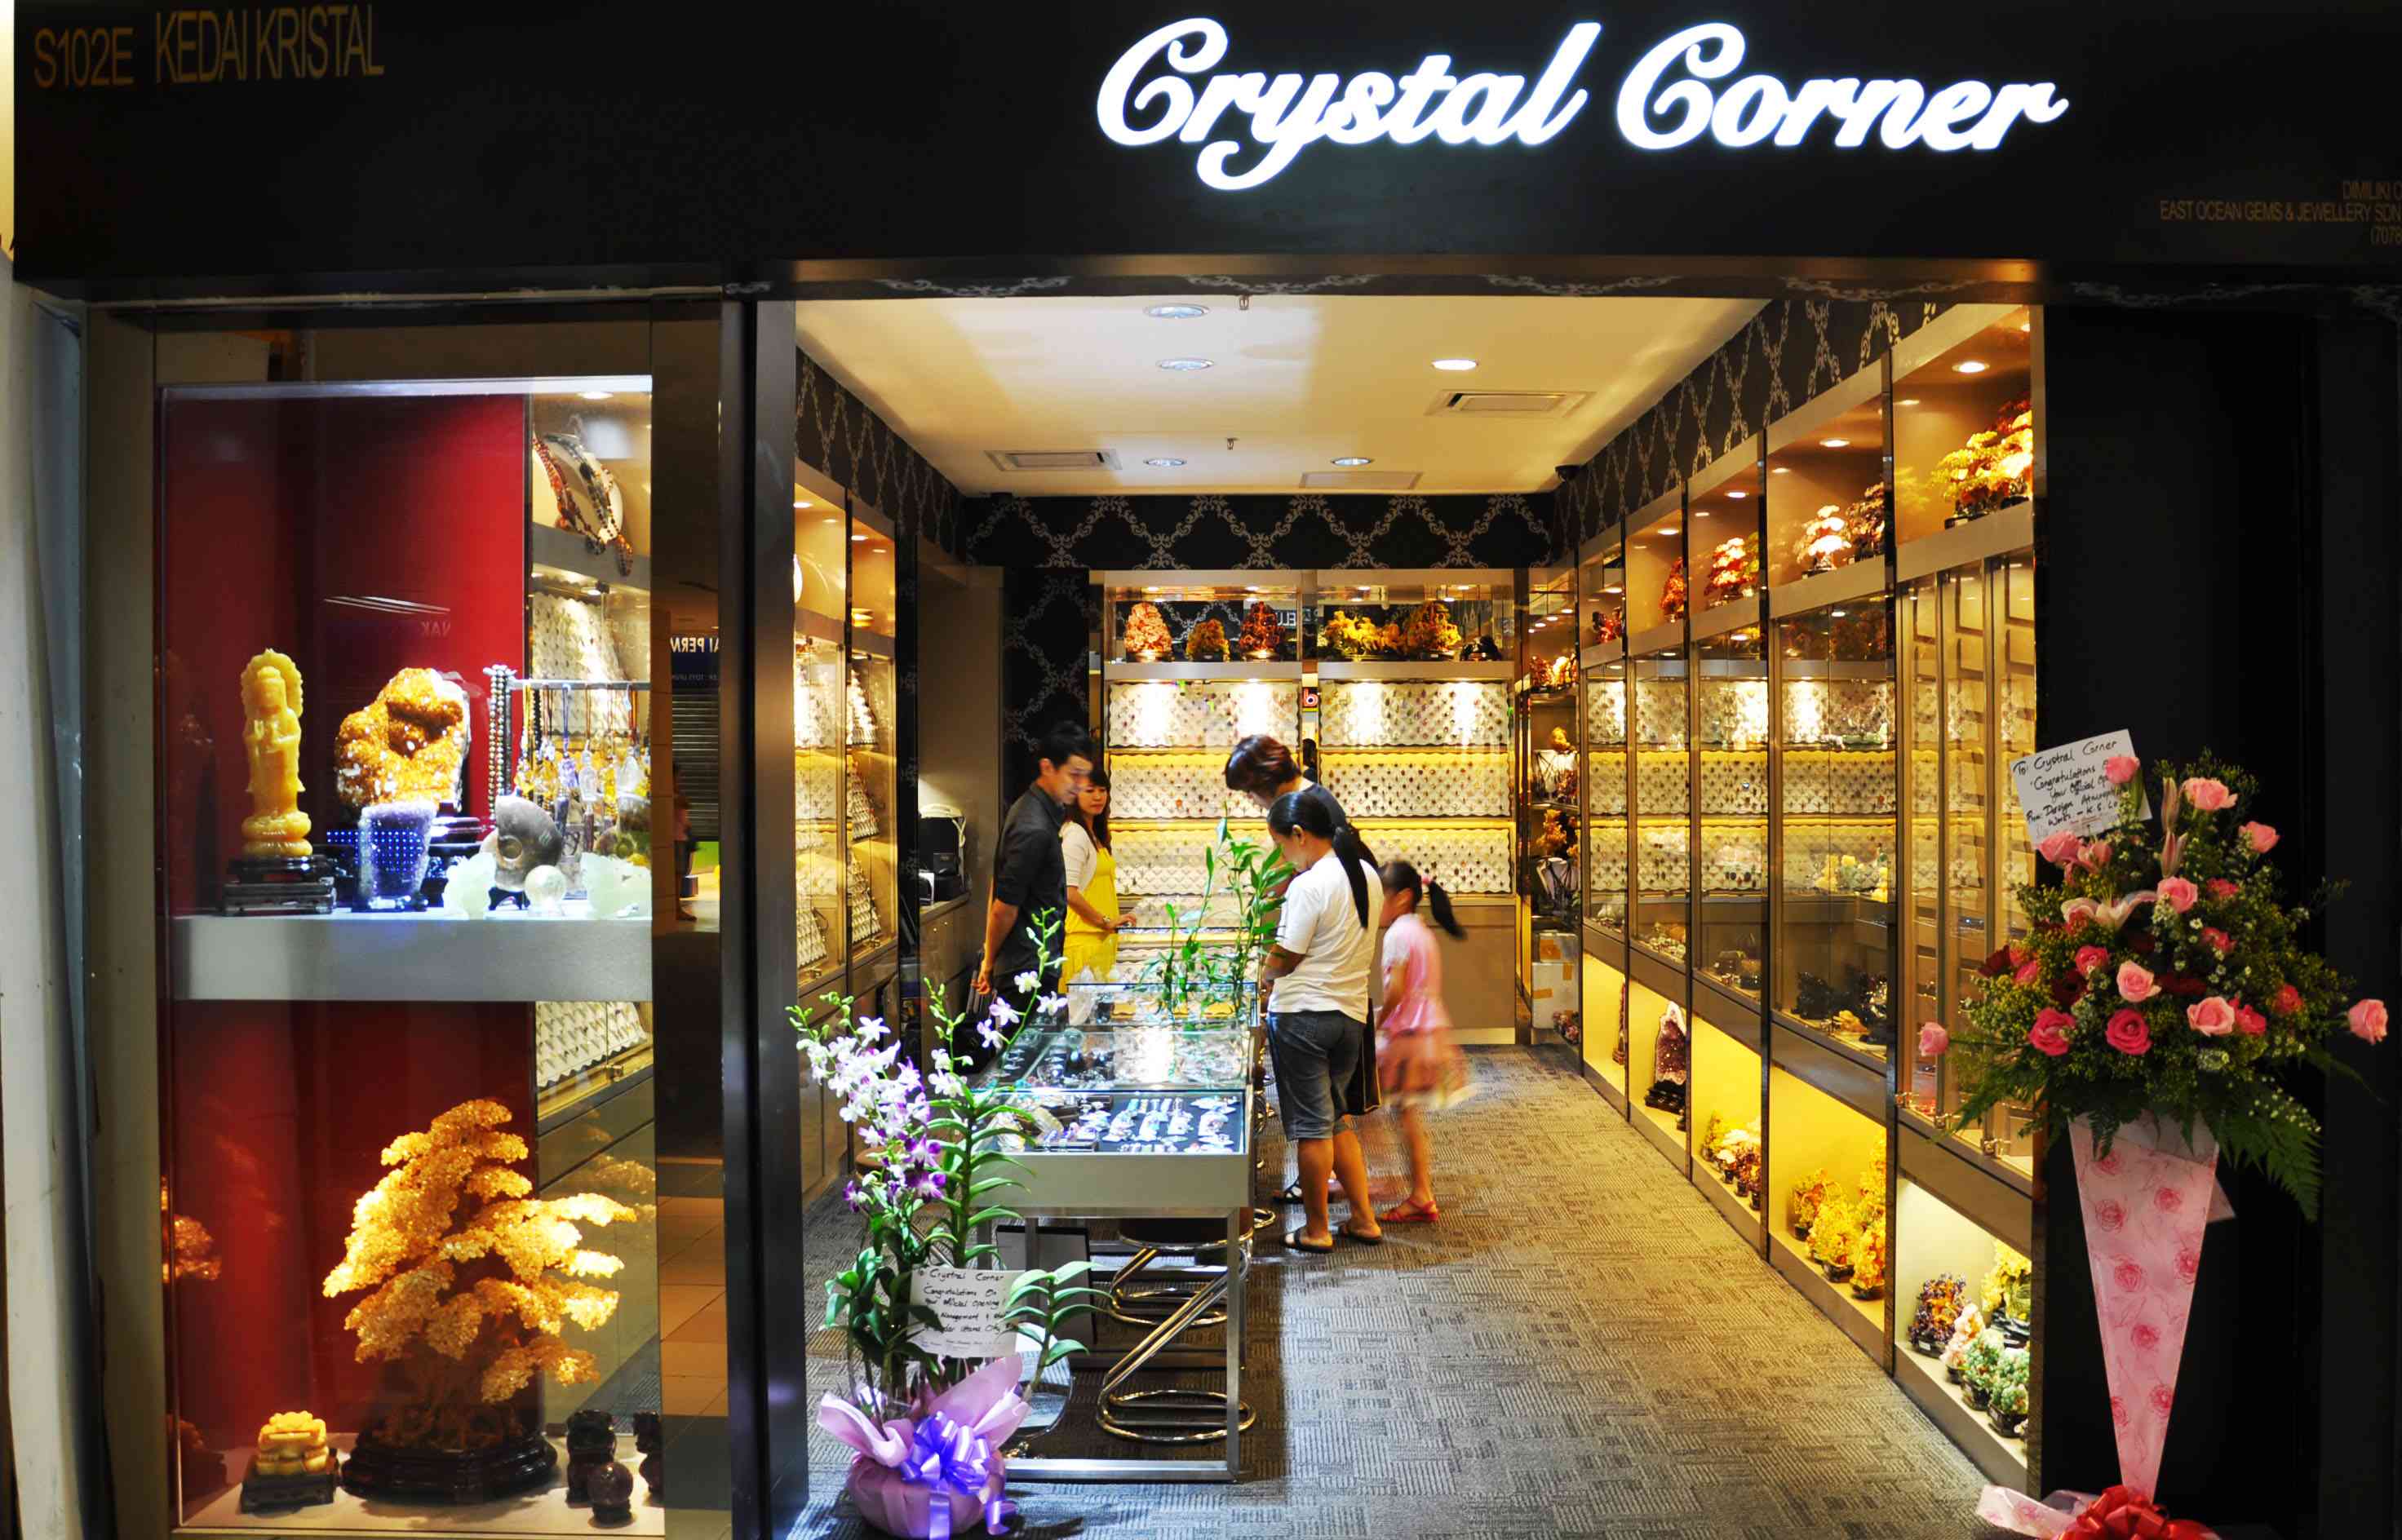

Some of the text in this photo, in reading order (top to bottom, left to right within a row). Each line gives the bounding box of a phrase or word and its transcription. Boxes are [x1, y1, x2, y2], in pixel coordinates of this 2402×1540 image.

[33, 4, 385, 89] S102E KEDAI KRISTAL
[1097, 16, 2070, 192] Crystal Corner
[2160, 200, 2194, 222] EAST
[2196, 201, 2243, 222] OCEAN
[2245, 201, 2284, 223] GEMS
[2297, 201, 2371, 223] JEWELLERY
